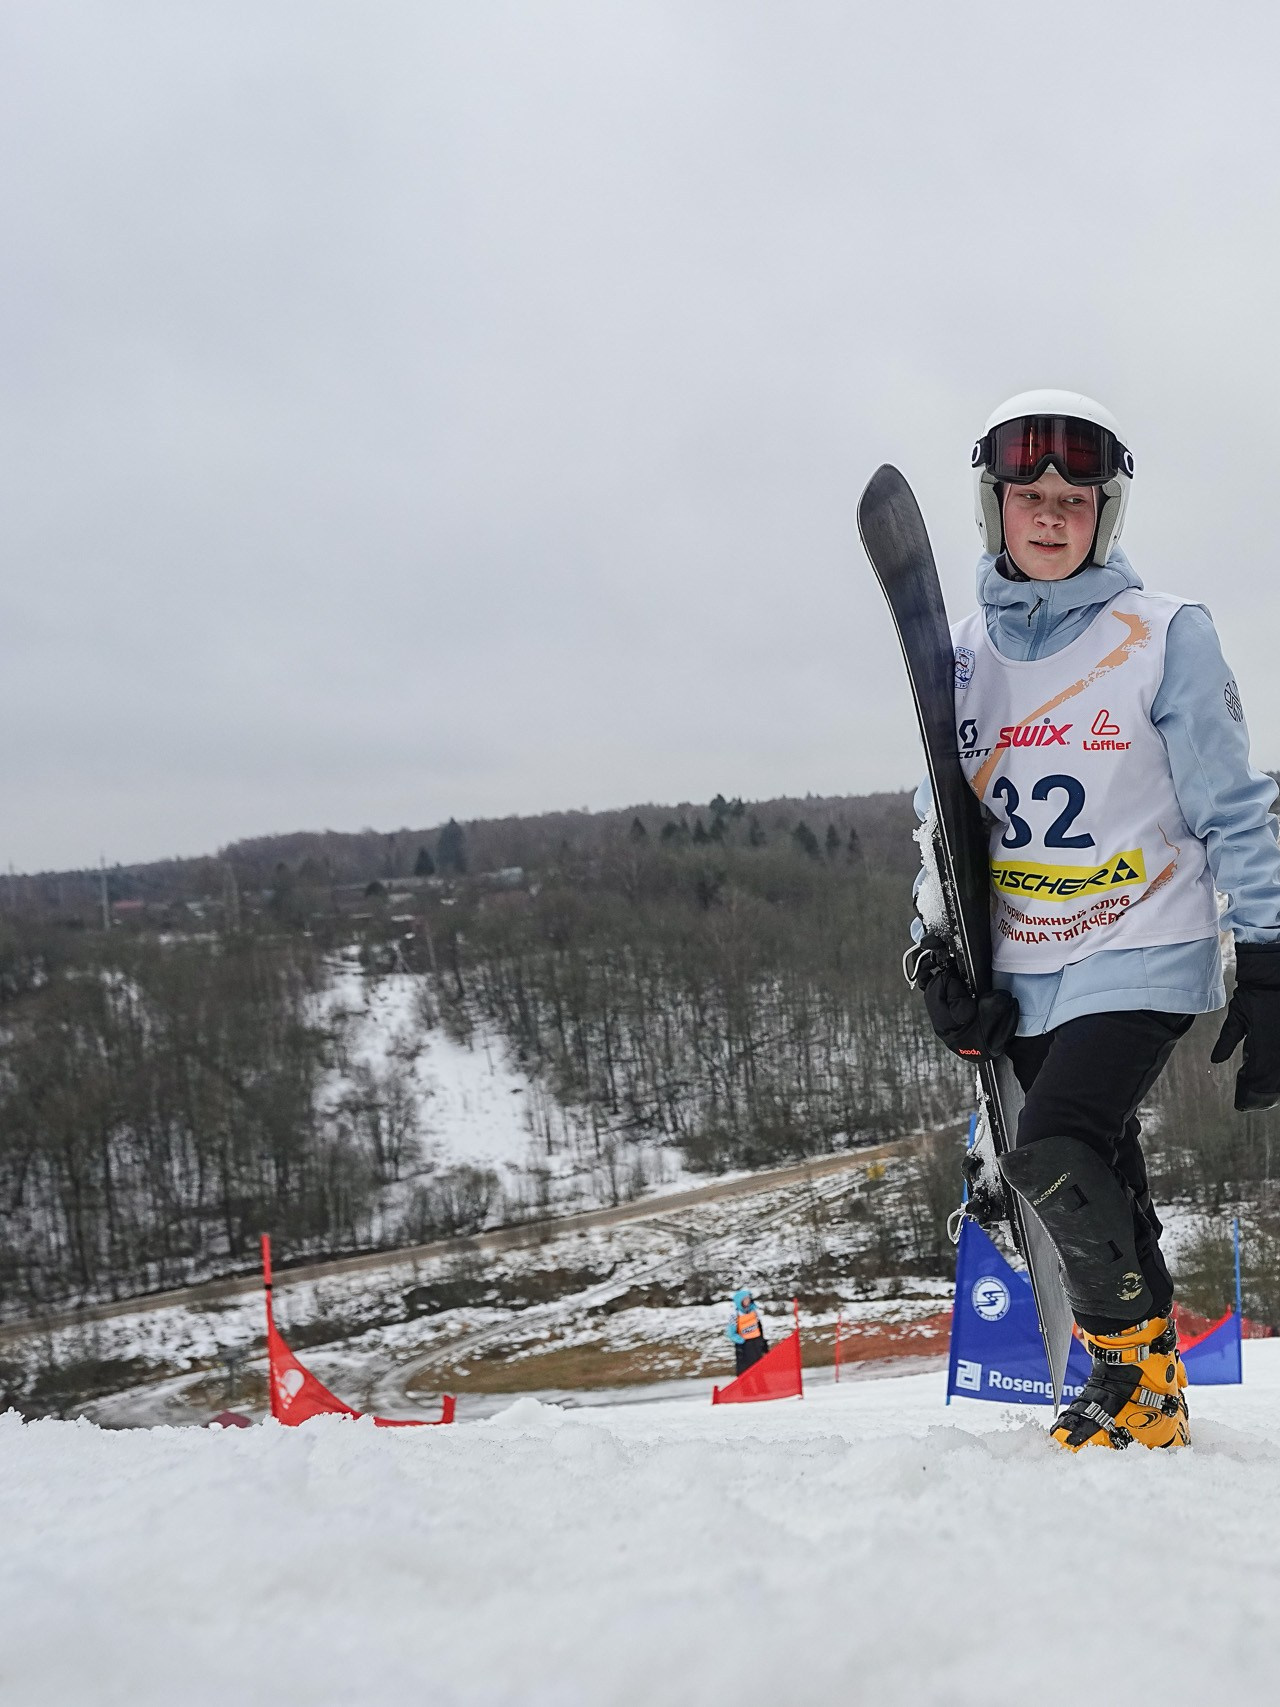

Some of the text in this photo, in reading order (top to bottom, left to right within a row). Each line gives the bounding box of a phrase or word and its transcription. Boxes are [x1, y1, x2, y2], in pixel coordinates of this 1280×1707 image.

[1083, 740, 1132, 751] Löffler
[958, 748, 992, 760] COTT
[992, 774, 1096, 849] 32
